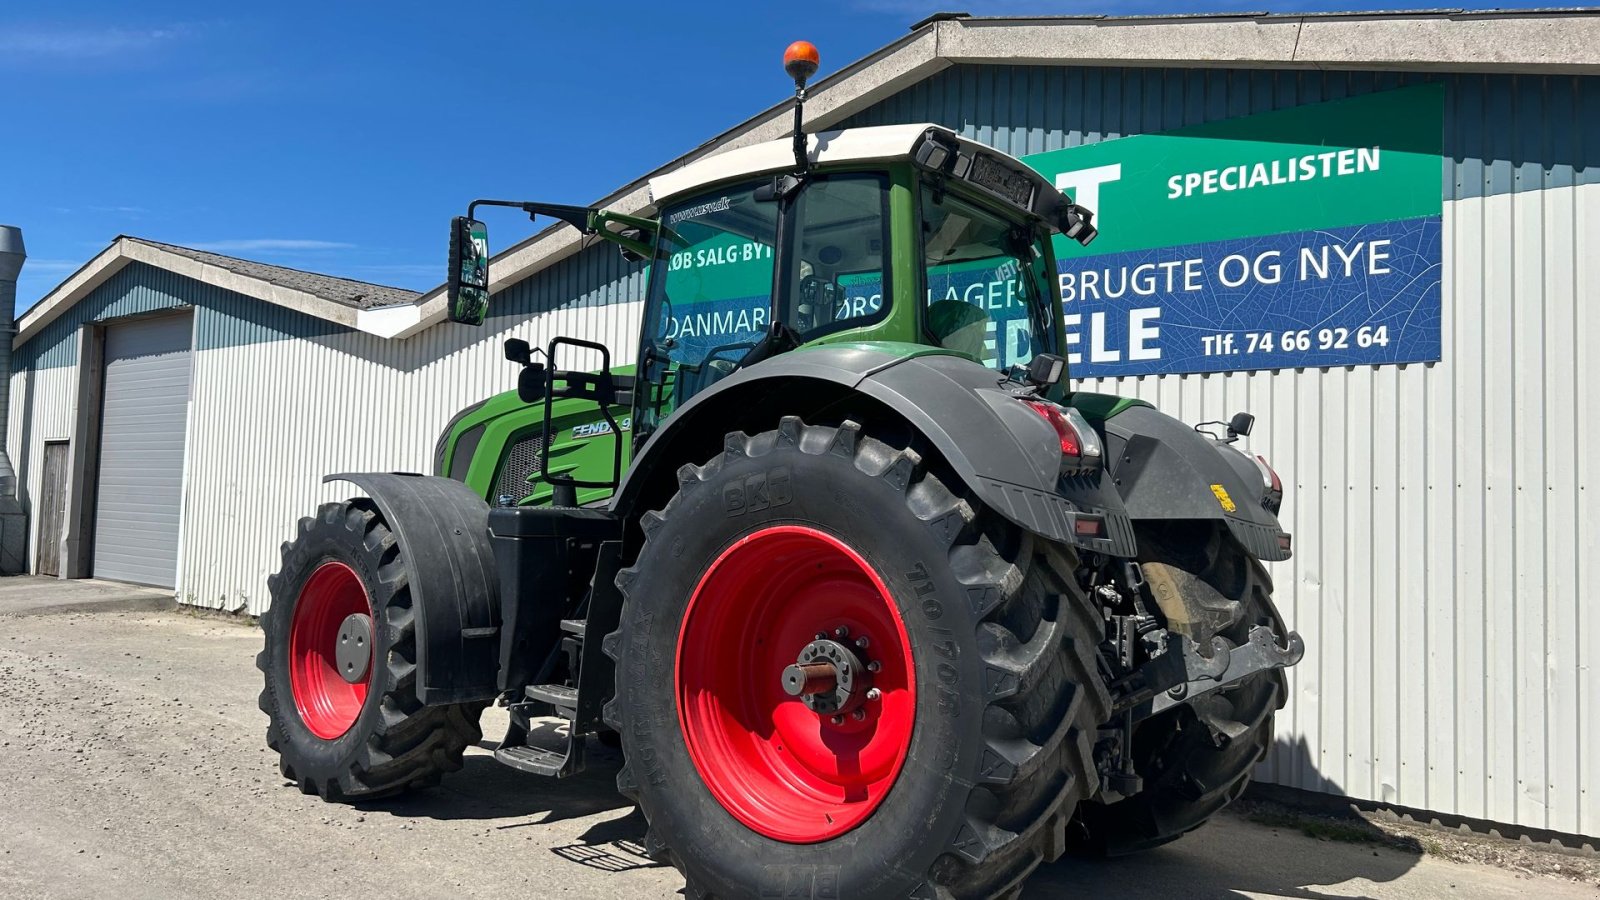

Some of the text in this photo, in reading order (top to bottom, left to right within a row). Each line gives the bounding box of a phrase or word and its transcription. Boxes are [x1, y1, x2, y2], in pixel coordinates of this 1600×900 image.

[1167, 146, 1380, 199] SPECIALISTEN
[665, 306, 771, 339] DANMAR
[1058, 258, 1203, 302] BRUGTE
[1218, 250, 1281, 288] OG
[1300, 239, 1391, 281] NYE
[1201, 325, 1389, 356] Tlf. 74 66 92 64
[572, 420, 618, 437] FEND
